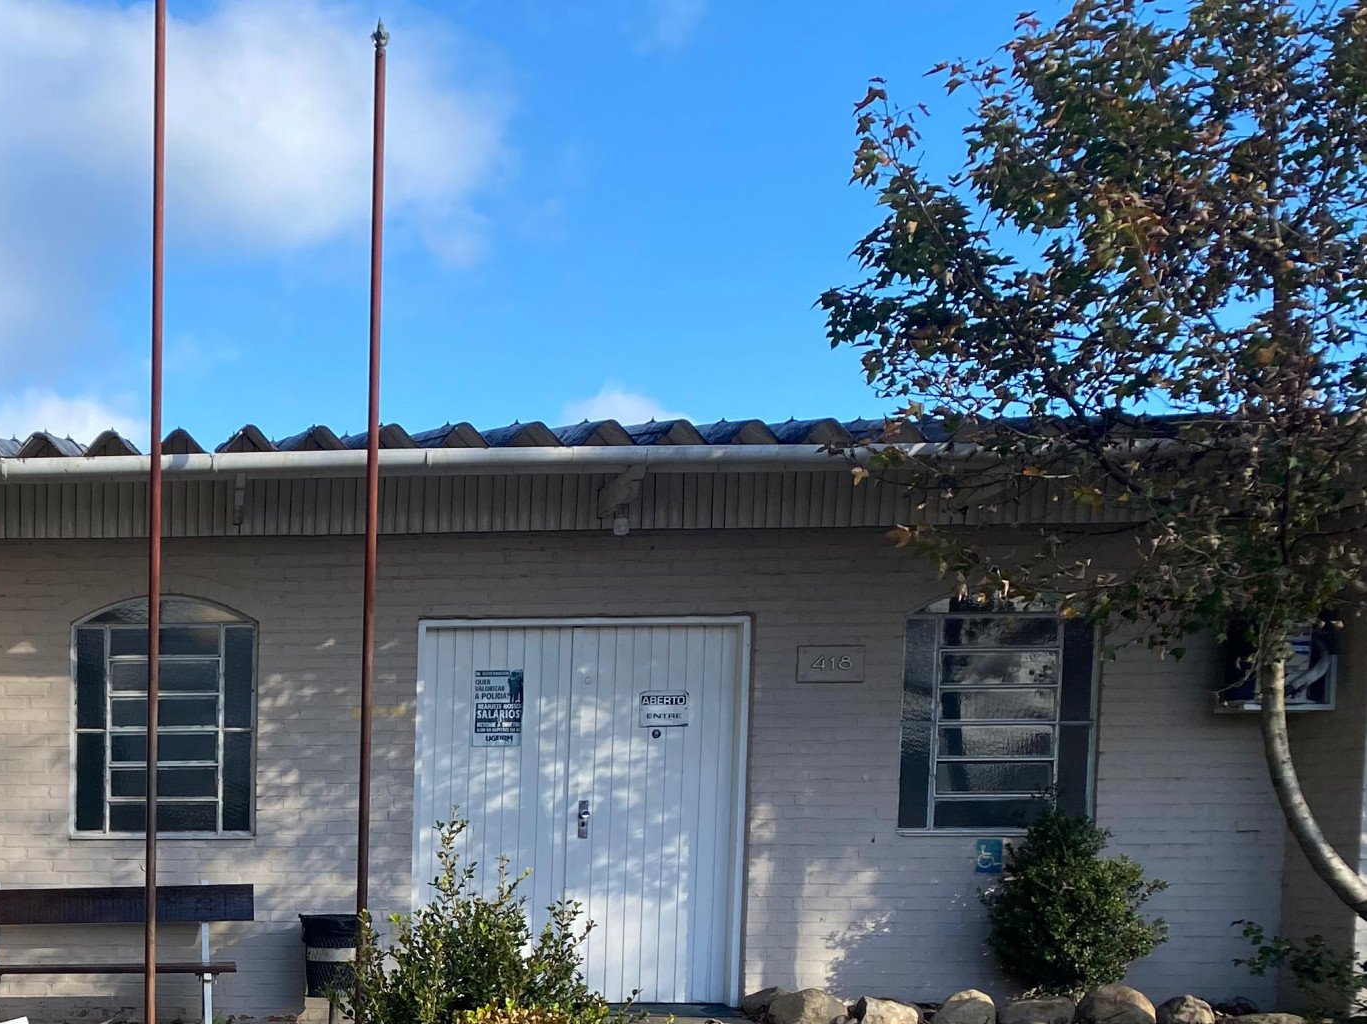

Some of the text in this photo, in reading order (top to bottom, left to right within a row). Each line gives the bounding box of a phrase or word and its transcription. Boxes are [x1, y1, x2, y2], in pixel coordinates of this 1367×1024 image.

[812, 655, 853, 670] 418
[481, 692, 510, 700] POLÍCIA?
[642, 695, 685, 705] ABERTO
[476, 709, 520, 718] SALÁRIOS
